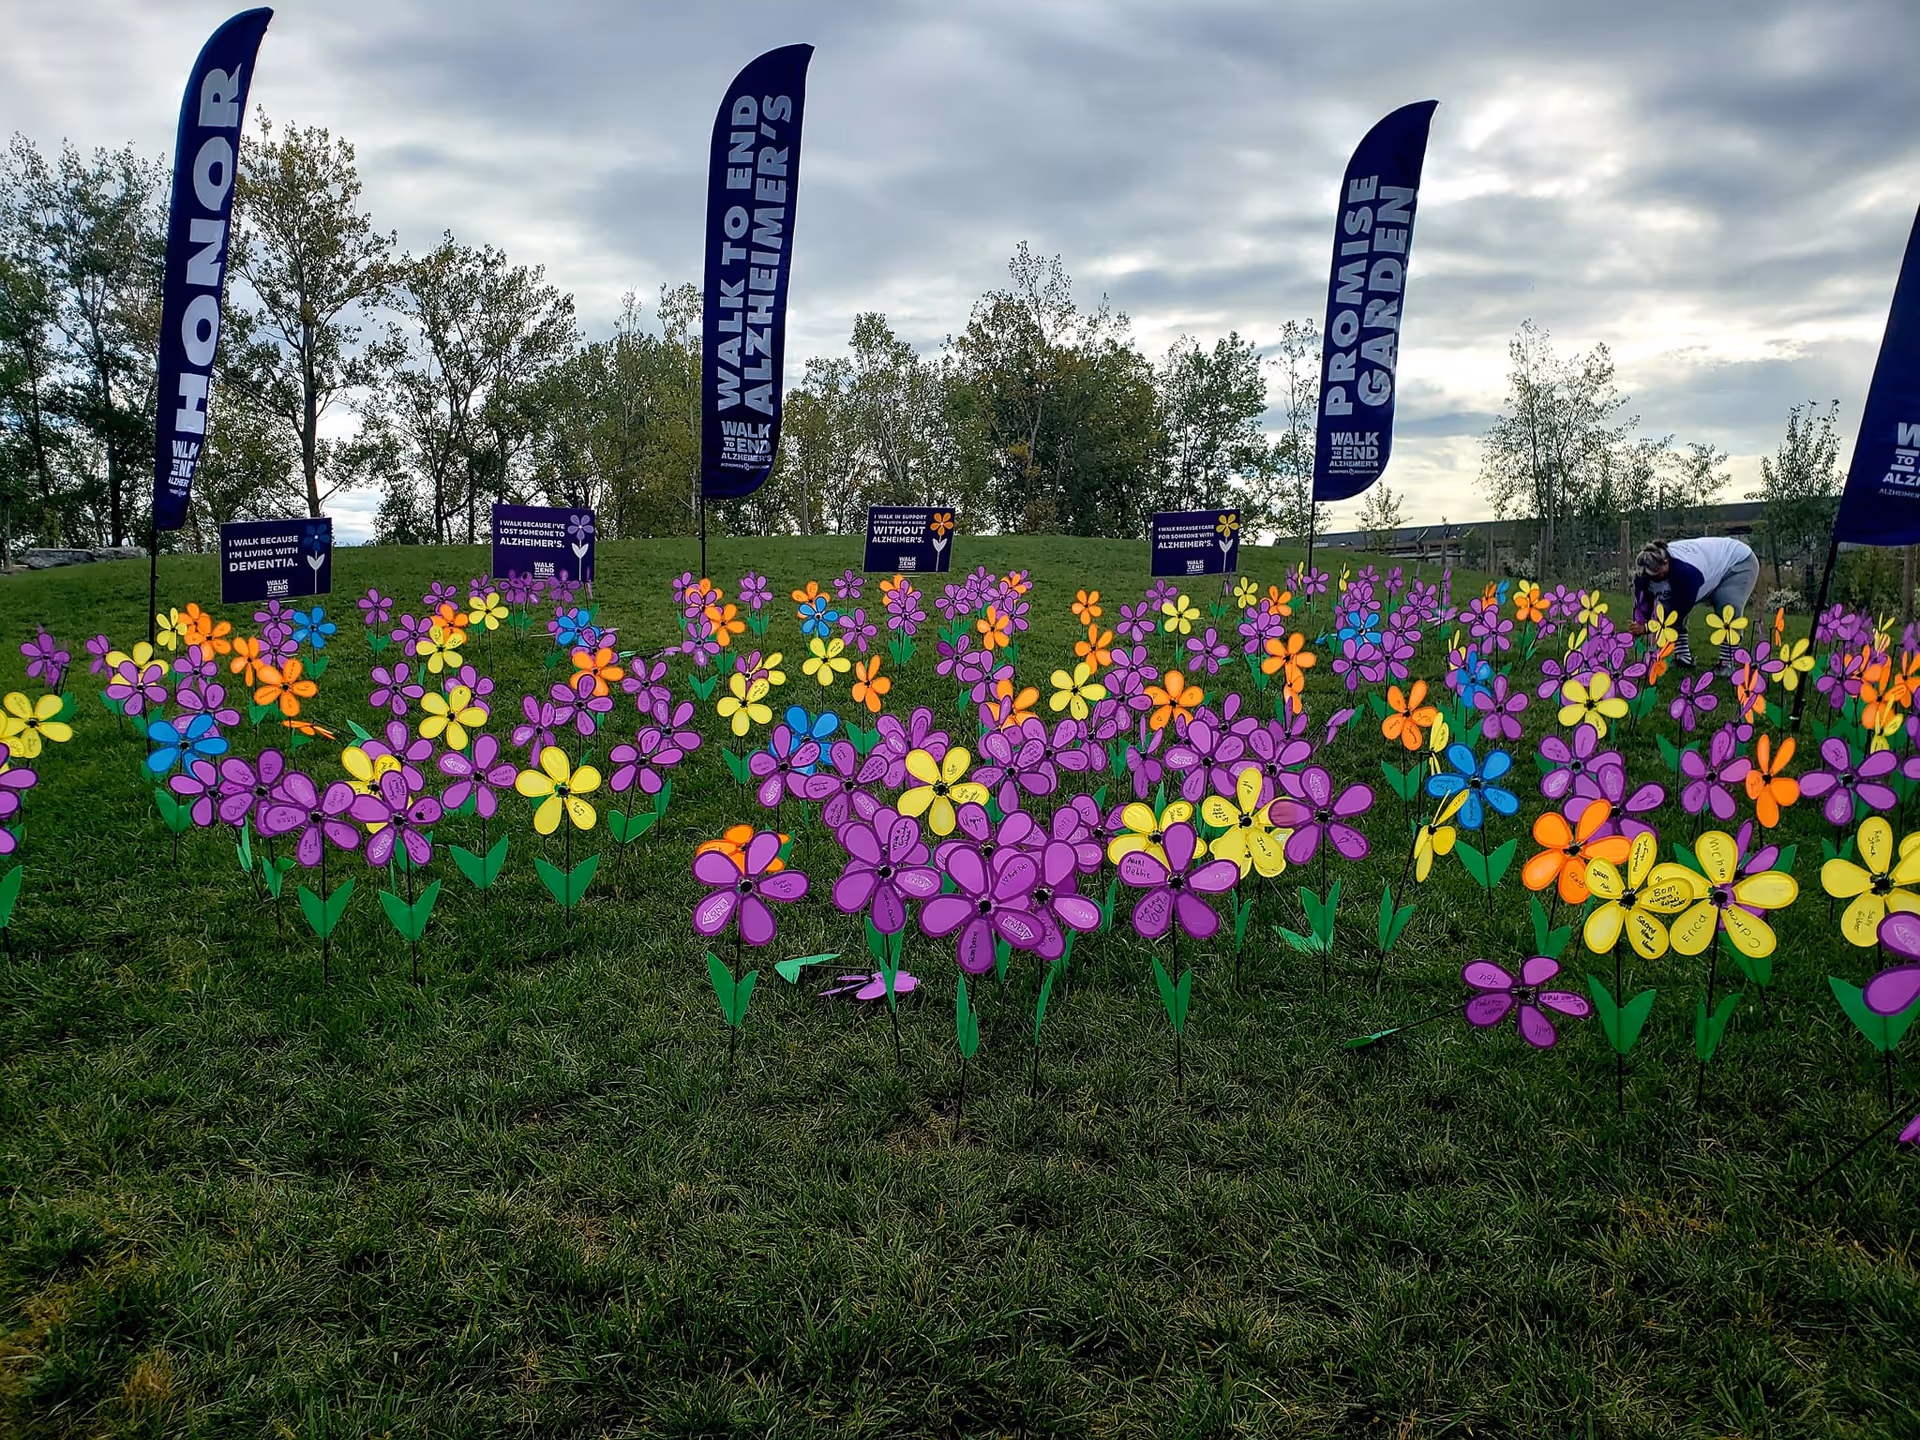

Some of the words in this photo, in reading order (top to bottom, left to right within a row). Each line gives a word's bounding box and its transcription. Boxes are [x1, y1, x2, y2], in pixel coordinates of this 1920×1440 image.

[726, 95, 759, 190] END
[721, 205, 750, 265] TO
[175, 63, 241, 434] HONOR
[744, 95, 792, 416] ALZHEIMER'S
[1325, 175, 1379, 416] PROMISE
[1357, 186, 1414, 407] GARDEN
[718, 277, 745, 412] WALK
[721, 420, 771, 438] WALK
[736, 438, 771, 454] END
[1331, 432, 1379, 446] WALK
[721, 452, 772, 462] ALZHEIMER'S
[1342, 446, 1379, 460] END
[1896, 455, 1915, 465] TO
[523, 521, 551, 529] BECAUSE
[873, 526, 926, 535] WITHOUT
[518, 529, 554, 537] SOMEONE
[234, 538, 259, 547] WALK
[260, 535, 299, 545] BECAUSE
[500, 537, 565, 549] ALZHEIMER'S.
[1157, 540, 1214, 549] ALZHEIMER'S.
[229, 551, 242, 559] I'M
[244, 549, 273, 558] LIVING
[275, 547, 299, 555] WITH
[229, 558, 298, 572] DEMENTIA.
[266, 579, 289, 587] WALK
